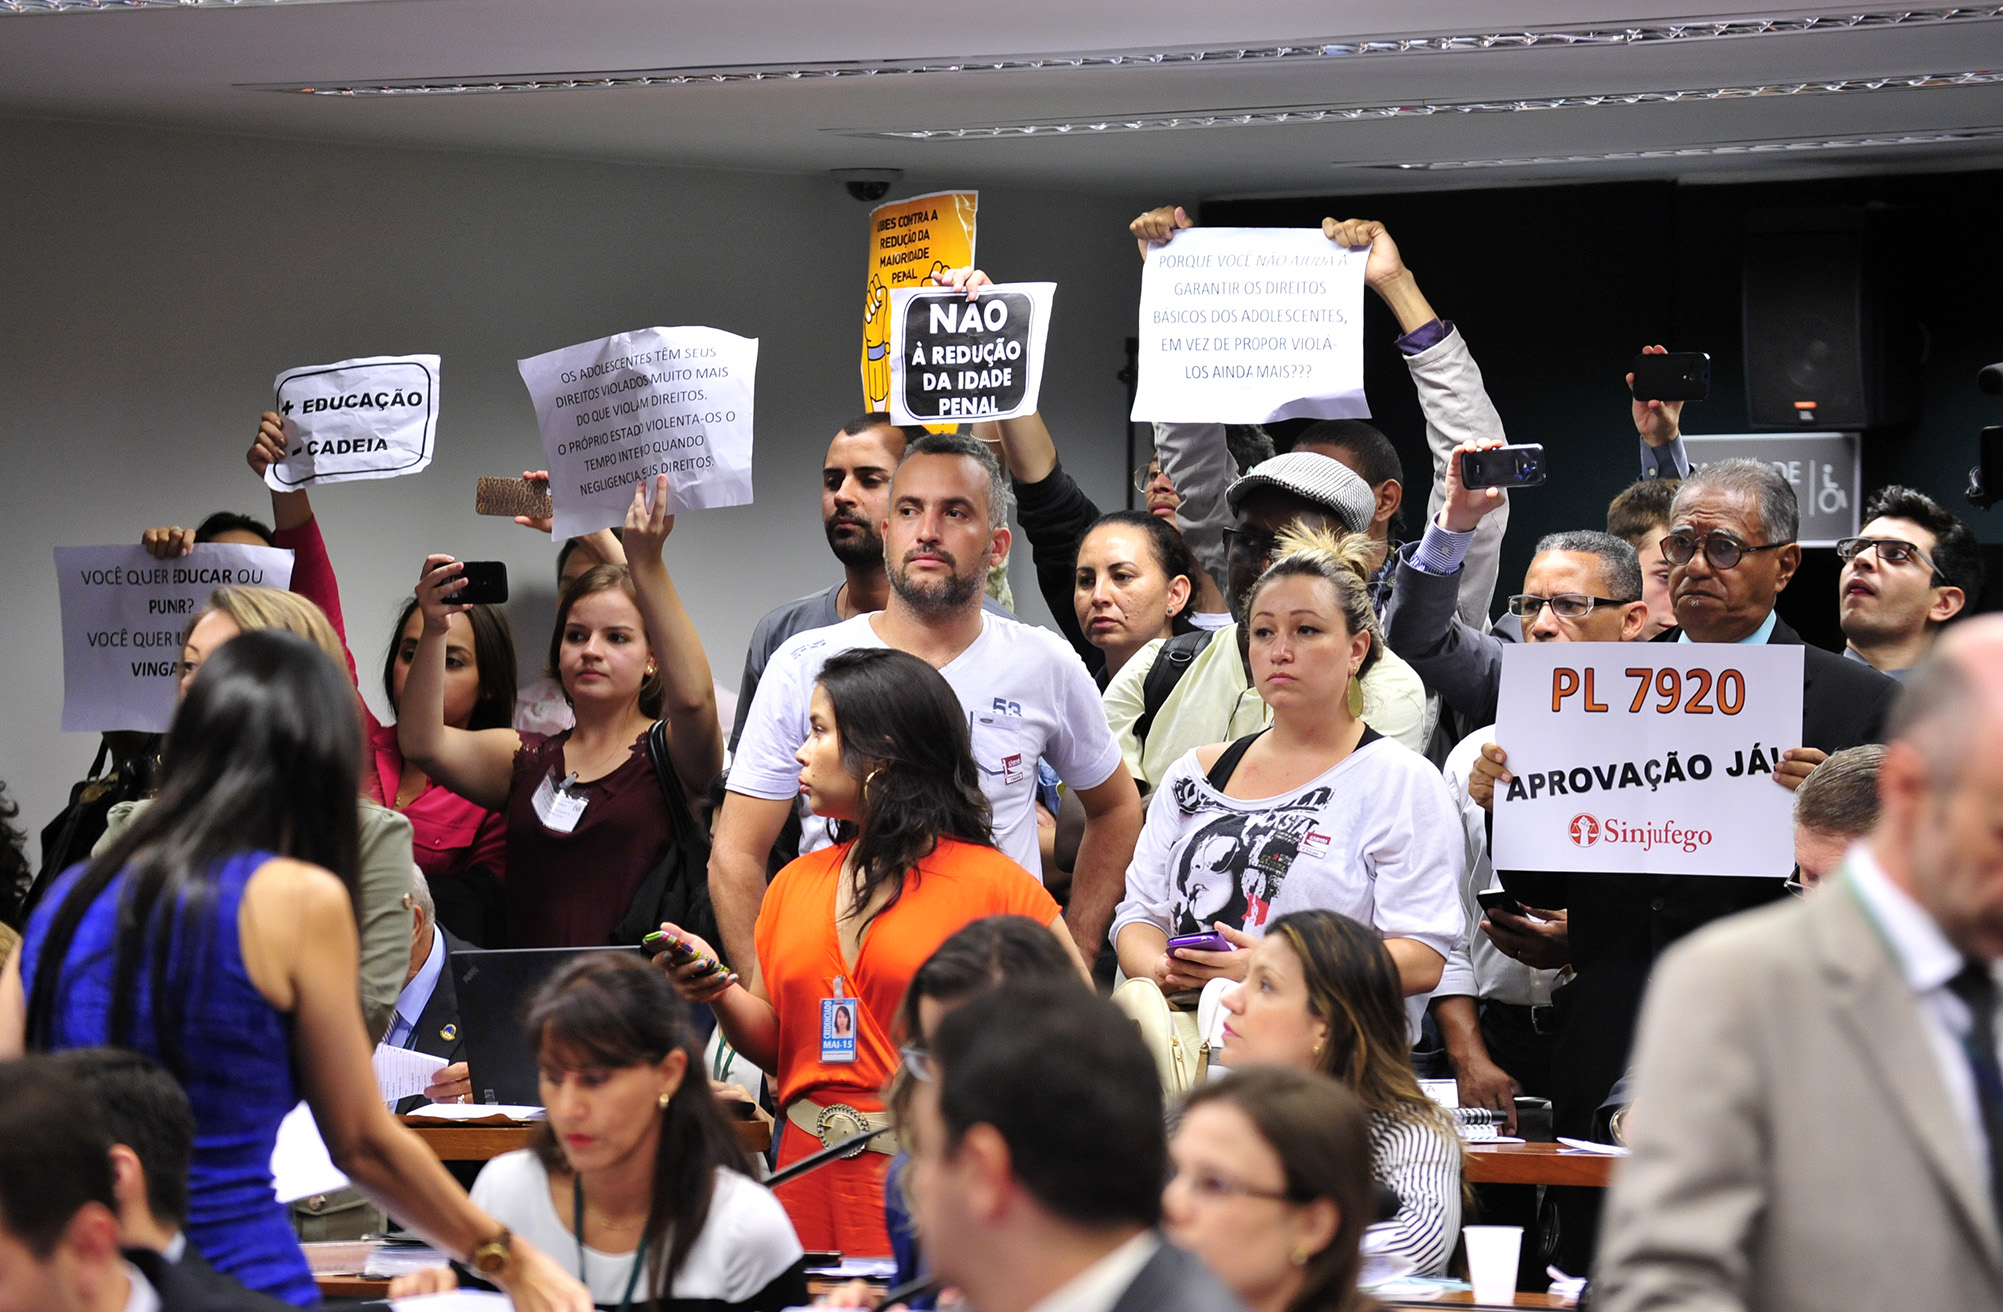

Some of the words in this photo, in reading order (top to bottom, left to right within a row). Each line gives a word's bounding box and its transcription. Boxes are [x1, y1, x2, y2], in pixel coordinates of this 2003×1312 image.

[898, 210, 929, 228] CONTRA
[931, 208, 939, 221] A
[880, 229, 917, 250] REDUÇÃO
[918, 228, 930, 242] DA
[880, 247, 930, 268] MAIORIDADE
[1158, 254, 1213, 269] PORQUE
[1216, 250, 1251, 268] VOCÊ
[1255, 251, 1288, 268] NÃO
[891, 268, 918, 284] PENAL
[1174, 281, 1240, 296] GARANTIR
[1244, 281, 1262, 295] OS
[1265, 281, 1327, 295] DIREITOS
[1153, 307, 1207, 324] BÁSICOS
[1211, 309, 1238, 323] DOS
[1241, 309, 1348, 325] ADOLESCENTES,
[911, 341, 926, 366] À
[931, 338, 1021, 368] REDUÇÃO
[1161, 337, 1182, 351] EM
[1186, 337, 1210, 351] VEZ
[1214, 337, 1230, 351] DE
[1234, 336, 1287, 351] PROPOR
[1291, 333, 1338, 351] VIOLÁ-
[560, 370, 577, 384] OS
[580, 352, 652, 380] ADOLESCENTES
[654, 346, 681, 363] TÊM
[684, 347, 717, 359] SEUS
[1185, 365, 1209, 380] LOS
[1212, 365, 1254, 379] AINDA
[1256, 364, 1313, 379] MAIS???
[555, 388, 600, 408] DIREITOS
[600, 374, 649, 396] VIOLADOS
[650, 368, 692, 384] MUITO
[695, 366, 729, 380] MAIS
[922, 371, 951, 391] DA
[957, 367, 1012, 390] IDADE
[281, 400, 295, 416] +
[302, 388, 423, 415] EDUCAÇÃO
[576, 412, 590, 427] DO
[591, 408, 611, 424] QUE
[613, 397, 649, 416] VIOLAM
[651, 389, 708, 407] DIREITOS.
[938, 395, 999, 417] PENAL
[557, 443, 567, 456] O
[569, 431, 609, 453] PRÓPRIO
[644, 411, 722, 432] VIOLENTA-OS
[725, 410, 736, 422] O
[306, 438, 389, 457] CADEIA
[584, 453, 617, 472] TEMPO
[652, 434, 705, 454] QUANDO
[579, 470, 641, 497] NEGLIGENCIA
[660, 455, 715, 474] DIREITOS.
[81, 566, 122, 585] VOCÊ
[126, 568, 169, 587] QUER
[172, 568, 233, 585] EDUCAR
[237, 568, 264, 585] OU
[87, 627, 128, 648] VOCÊ
[133, 630, 172, 649] QUER
[131, 660, 178, 678] VINGA
[1551, 667, 1609, 714] PL
[1624, 667, 1747, 716] 7920
[1505, 750, 1713, 802] APROVAÇÃO
[1725, 742, 1782, 778] JÁ!
[1603, 818, 1713, 853] Sinjufego
[822, 1039, 853, 1050] MAI-15
